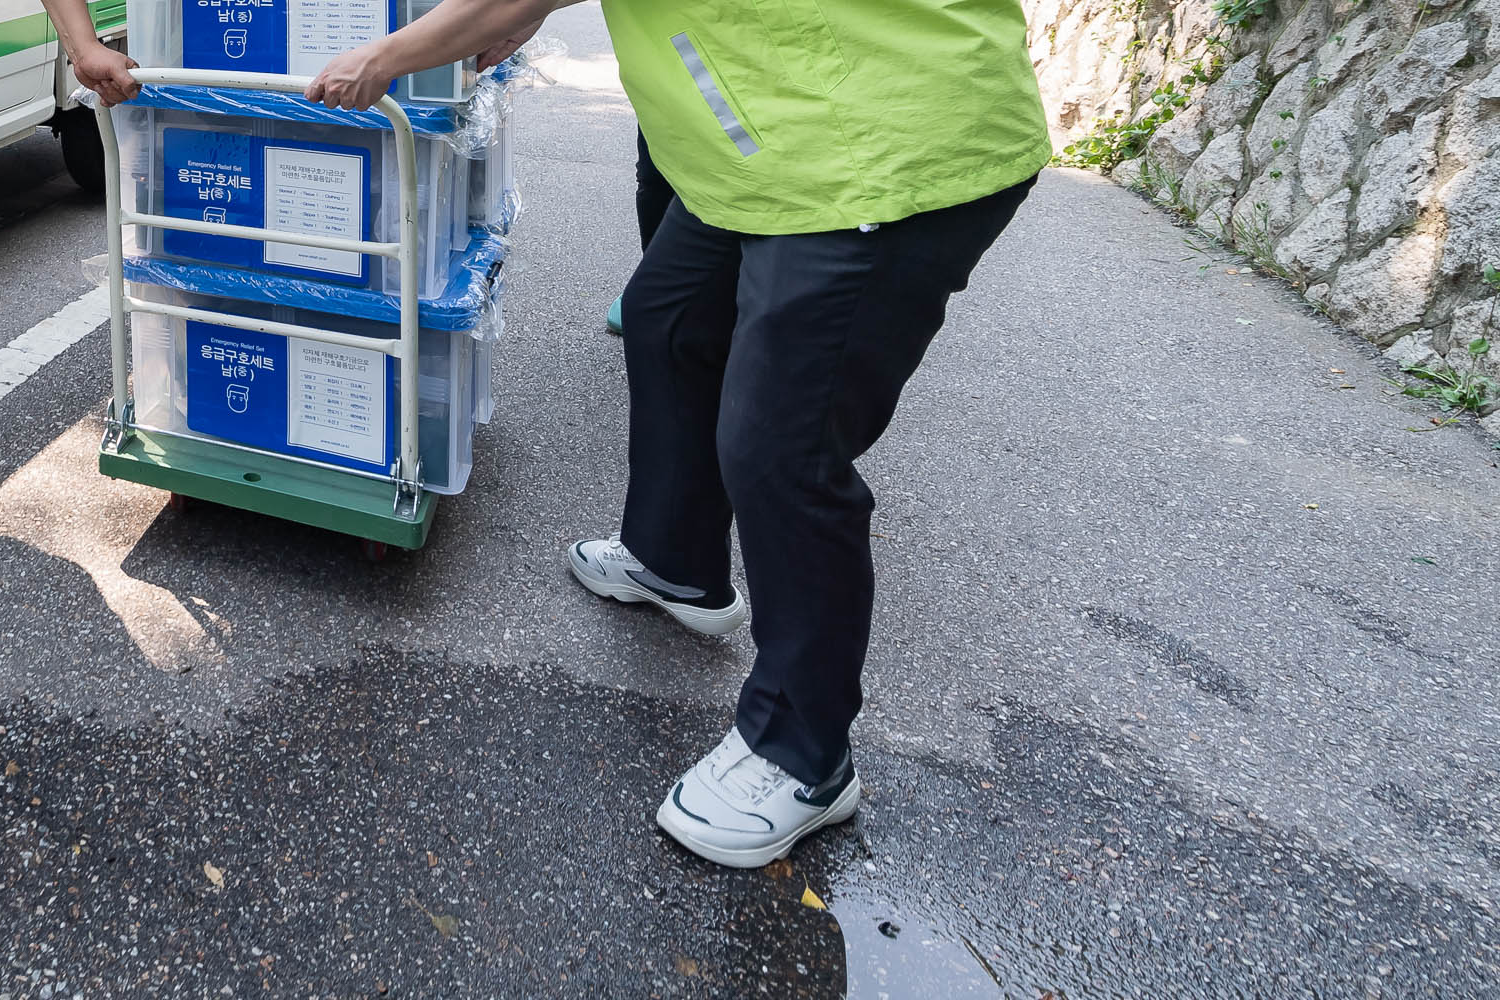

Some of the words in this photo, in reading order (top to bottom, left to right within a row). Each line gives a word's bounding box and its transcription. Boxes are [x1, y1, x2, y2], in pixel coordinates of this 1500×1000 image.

[217, 9, 253, 23] 남(중)
[187, 160, 216, 169] Emergency
[217, 163, 232, 171] Relief
[177, 168, 252, 190] 응급구호세트
[198, 186, 231, 203] 남(중)
[210, 337, 239, 348] Emergency
[240, 342, 255, 350] Relief
[255, 345, 265, 353] Set
[200, 344, 275, 371] 응급구호세트
[221, 363, 255, 382] 남(중)
